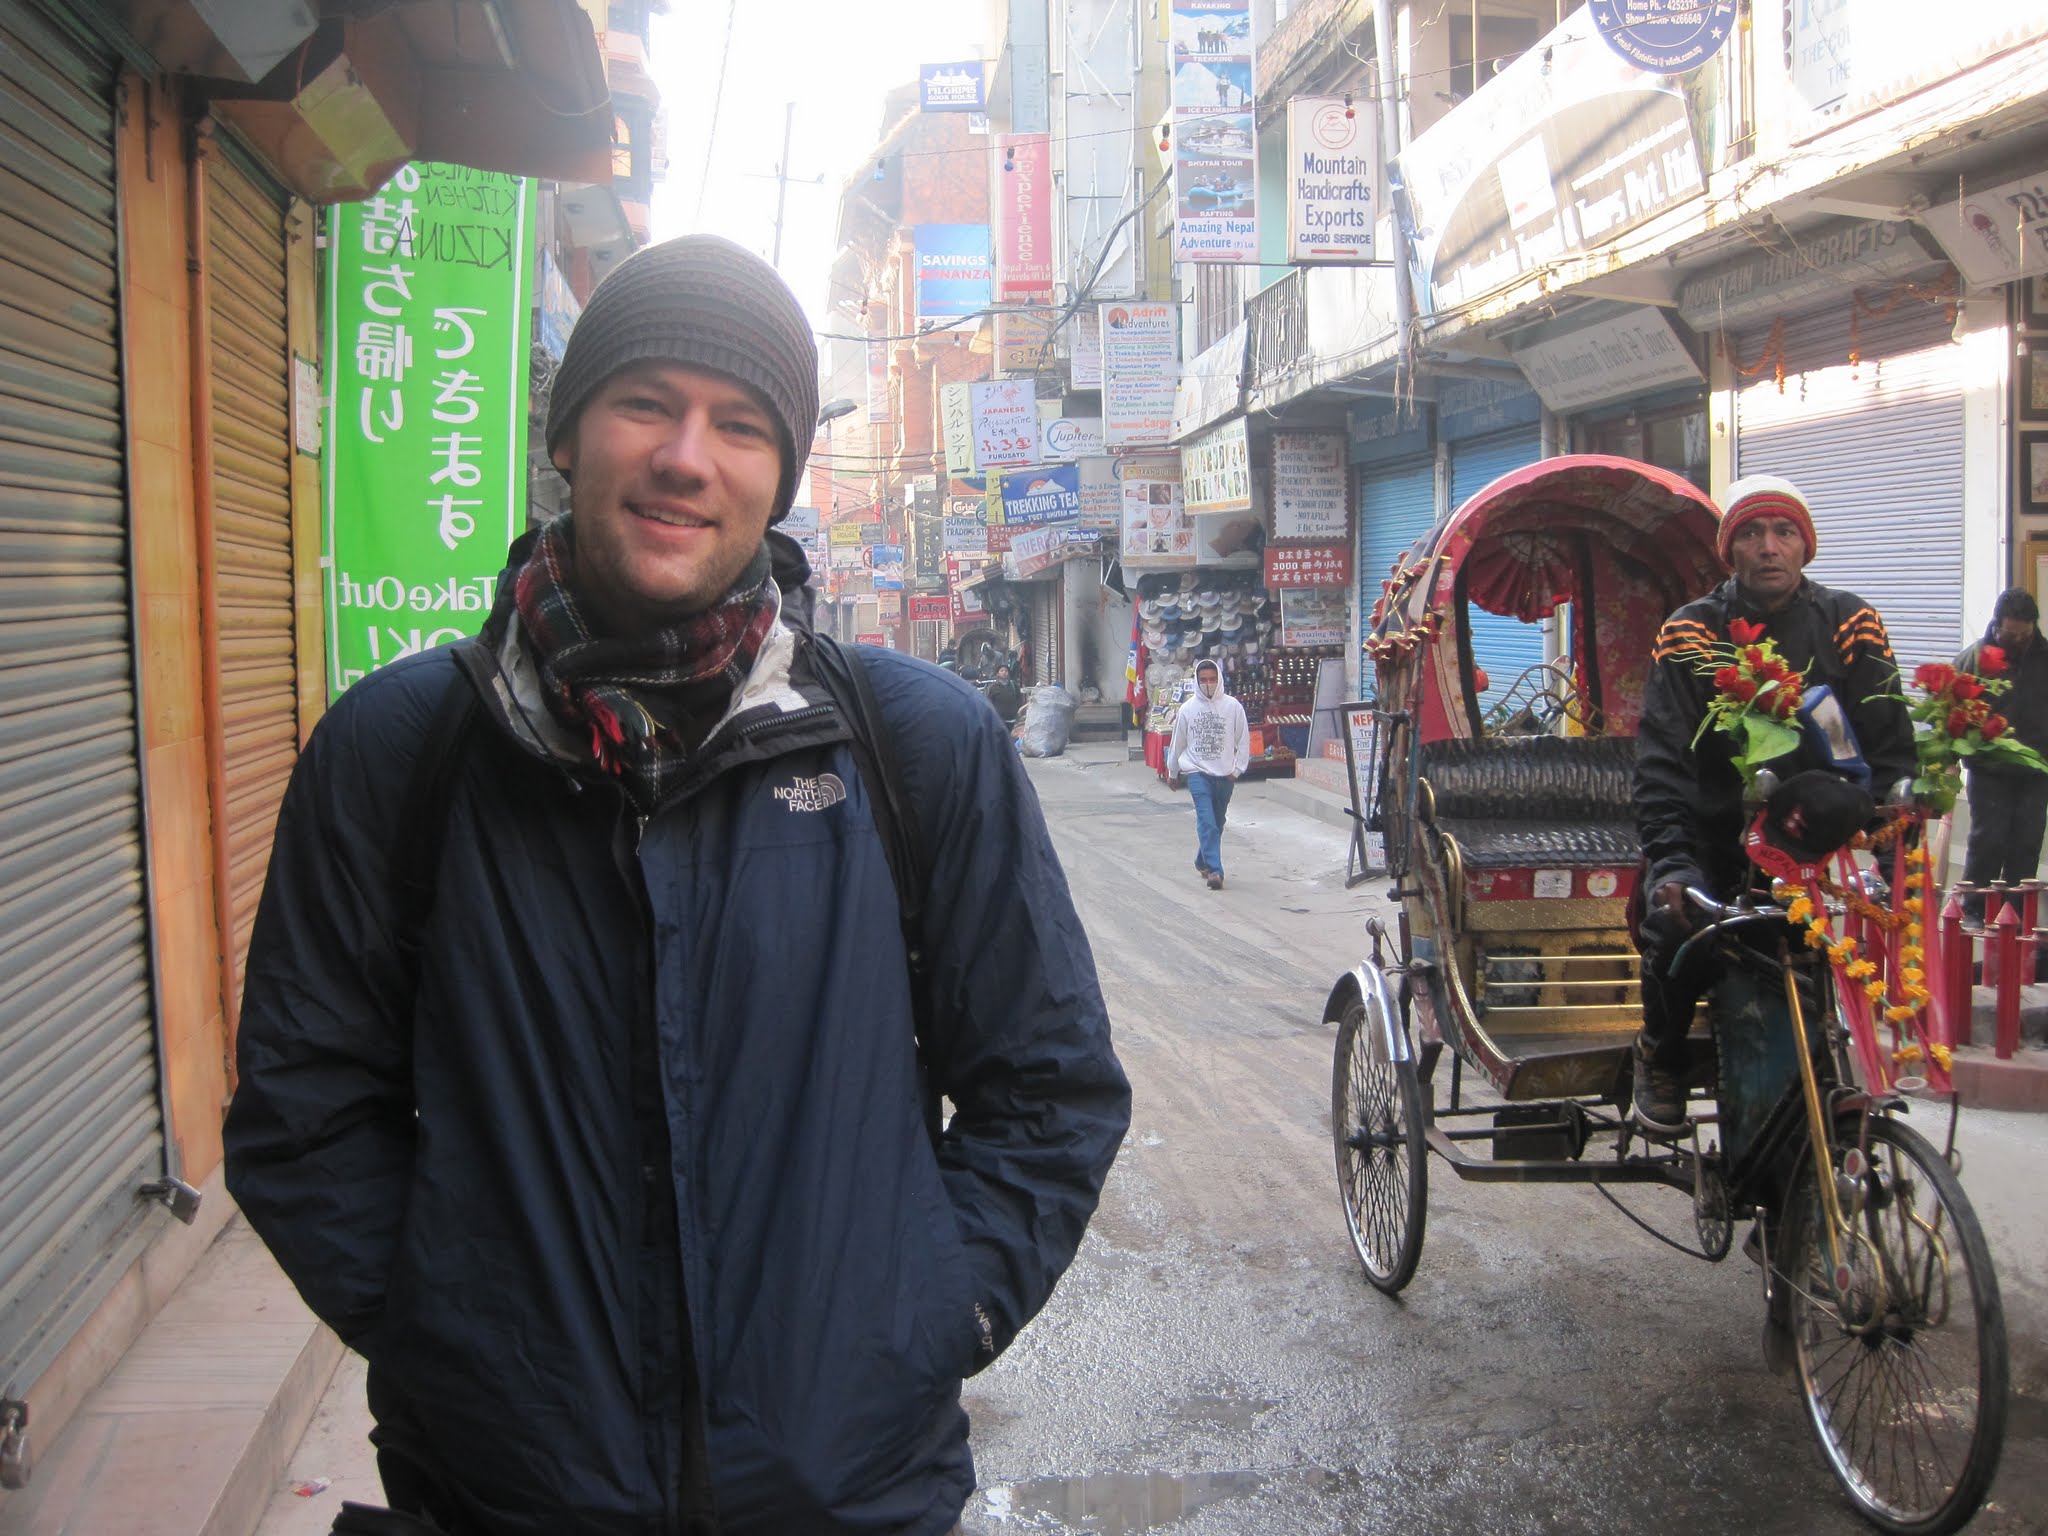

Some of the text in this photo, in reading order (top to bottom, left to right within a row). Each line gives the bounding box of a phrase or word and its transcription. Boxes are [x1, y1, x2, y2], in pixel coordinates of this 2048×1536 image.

[928, 86, 977, 95] PILGRIMS
[1304, 152, 1367, 175] Mountain
[1298, 178, 1371, 201] Handicrafts
[1016, 160, 1033, 261] Experience
[1305, 204, 1364, 232] Exports
[1180, 221, 1255, 235] Amazing Nepal
[1180, 237, 1232, 249] Adventure
[1300, 233, 1371, 245] CARGO SERVICE
[922, 255, 986, 266] SAVINGS
[1681, 264, 1754, 312] MOUNTAIN
[1762, 220, 1897, 287] HANDICRAFTS
[918, 268, 992, 280] BONANZA
[1132, 306, 1168, 317] Adrift
[982, 406, 1026, 414] JAPANESE
[1053, 430, 1095, 443] Jupiter
[988, 452, 1026, 460] FURUSATO
[1005, 491, 1079, 516] TREKKING TEA
[792, 776, 818, 789] THE
[774, 786, 822, 801] NORTH
[789, 799, 824, 812] FACE
